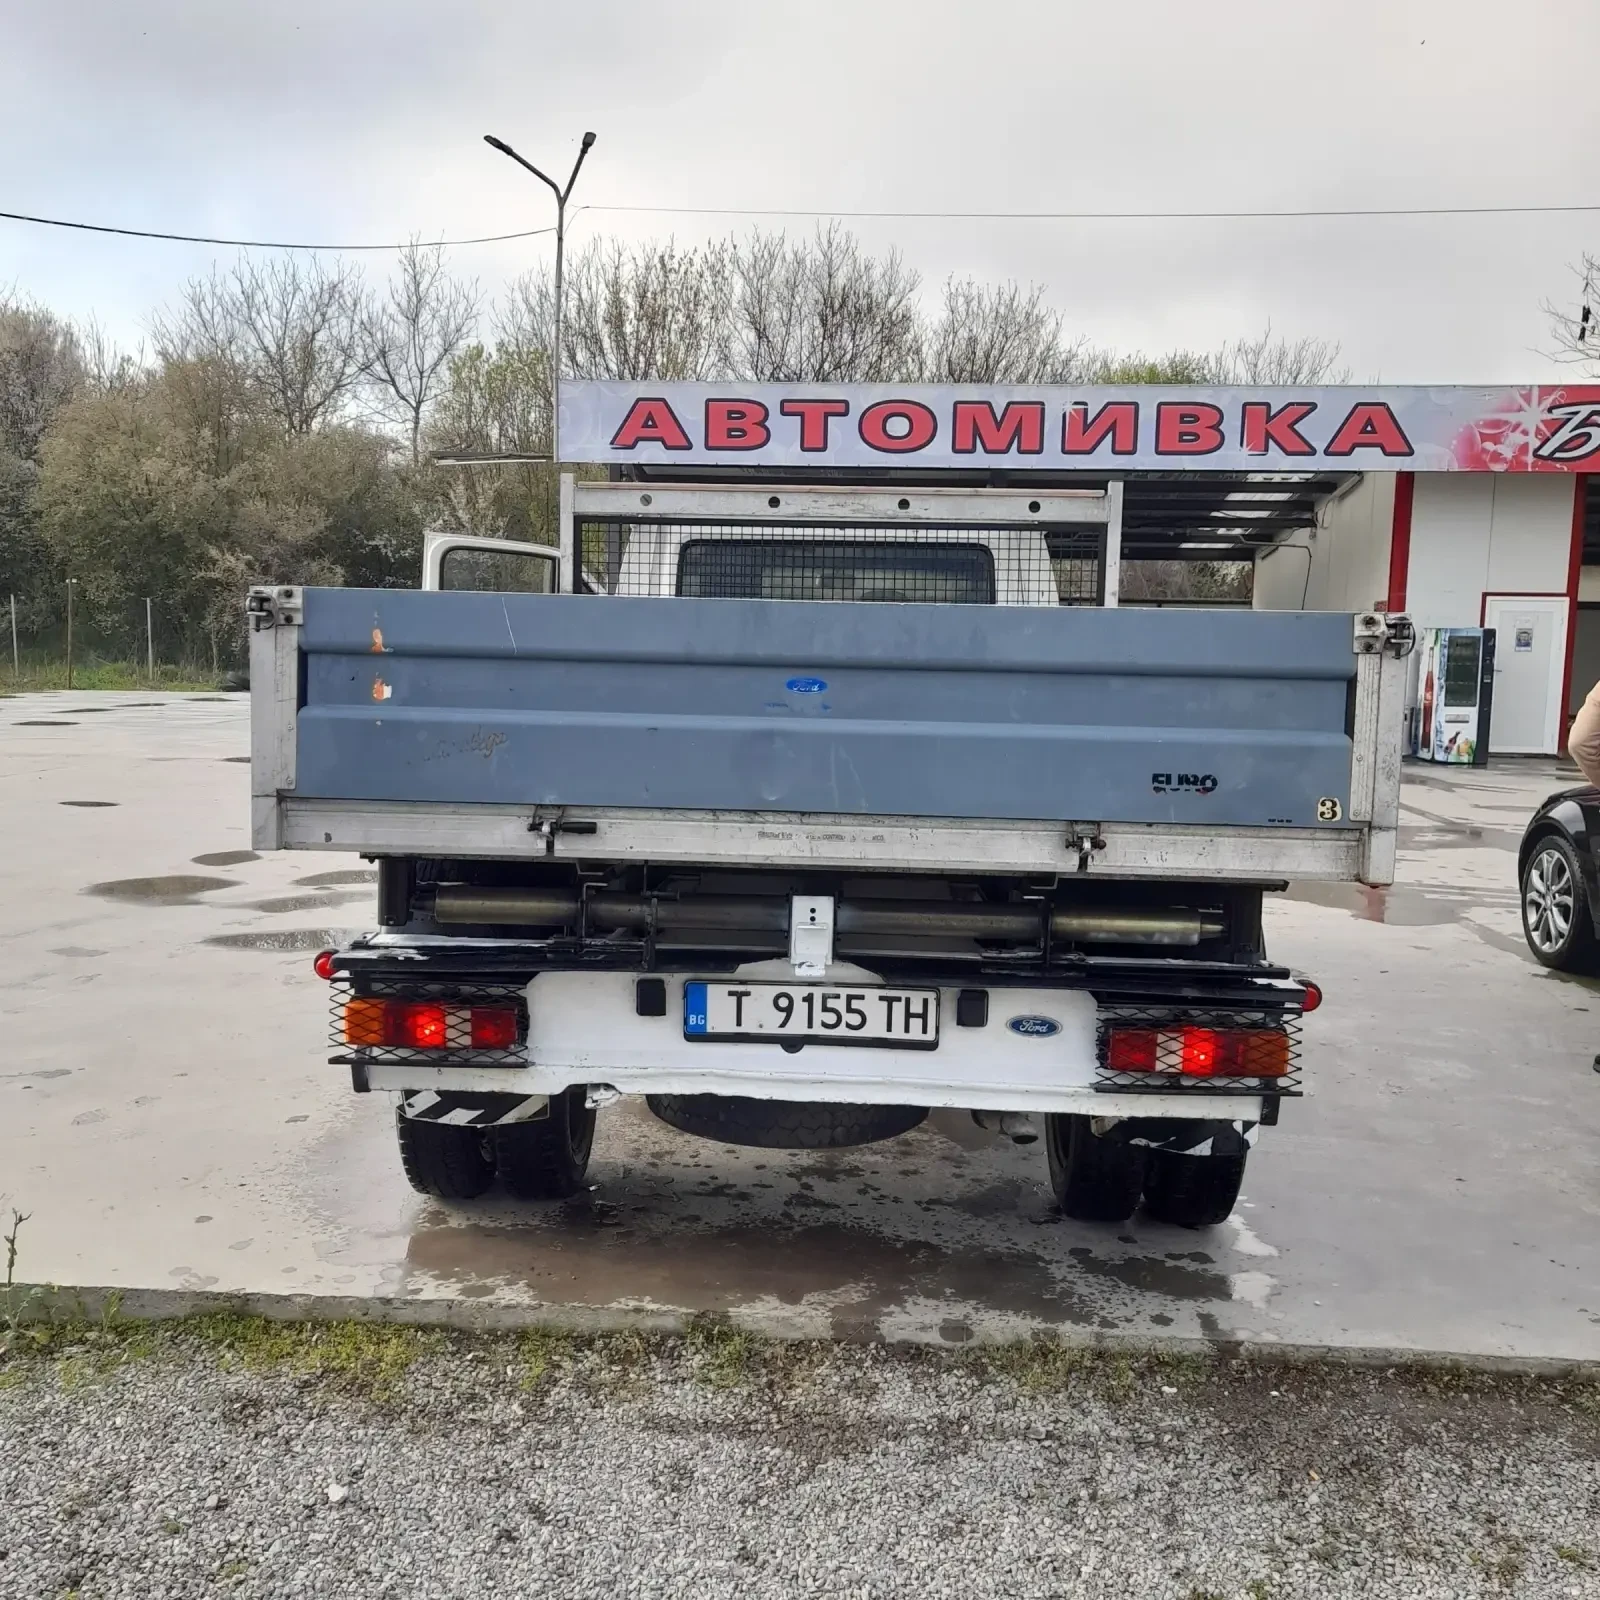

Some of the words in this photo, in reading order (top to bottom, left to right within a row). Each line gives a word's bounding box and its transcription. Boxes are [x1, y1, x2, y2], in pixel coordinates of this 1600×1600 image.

[610, 397, 1414, 456] АВТОМИВКА
[1319, 798, 1338, 820] 3
[689, 1014, 705, 1026] BG
[727, 990, 752, 1027] T
[772, 991, 868, 1031] 9155
[878, 995, 929, 1035] TH
[1019, 1019, 1049, 1034] Ford
